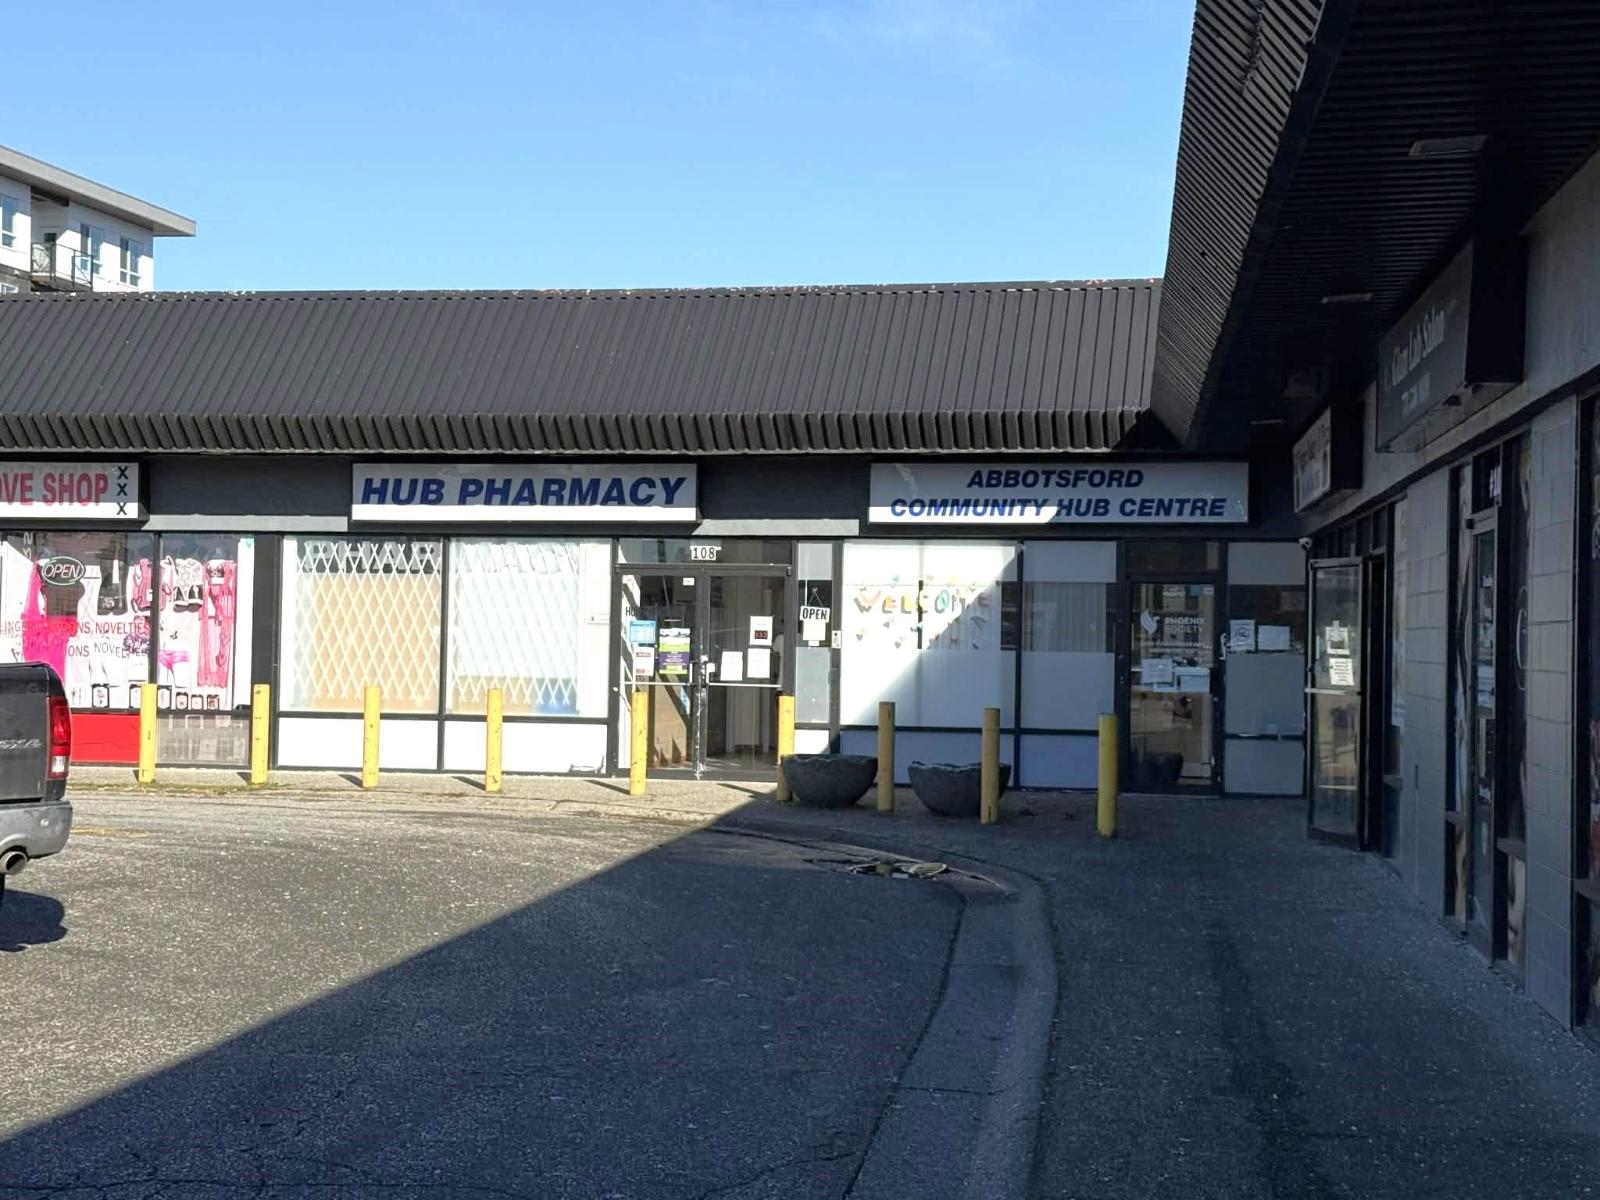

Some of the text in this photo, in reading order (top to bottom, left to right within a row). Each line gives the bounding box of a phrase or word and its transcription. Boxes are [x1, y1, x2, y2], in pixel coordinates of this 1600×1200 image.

[967, 469, 1144, 488] ABBOTSFORD
[42, 472, 109, 506] SHOP
[361, 477, 687, 506] HUB PHARMACY
[890, 498, 1227, 517] COMMUNITY HUB CENTRE
[692, 546, 715, 559] 108
[45, 563, 80, 578] OPEN
[802, 607, 828, 620] OPEN
[1165, 617, 1206, 625] PHOENIX
